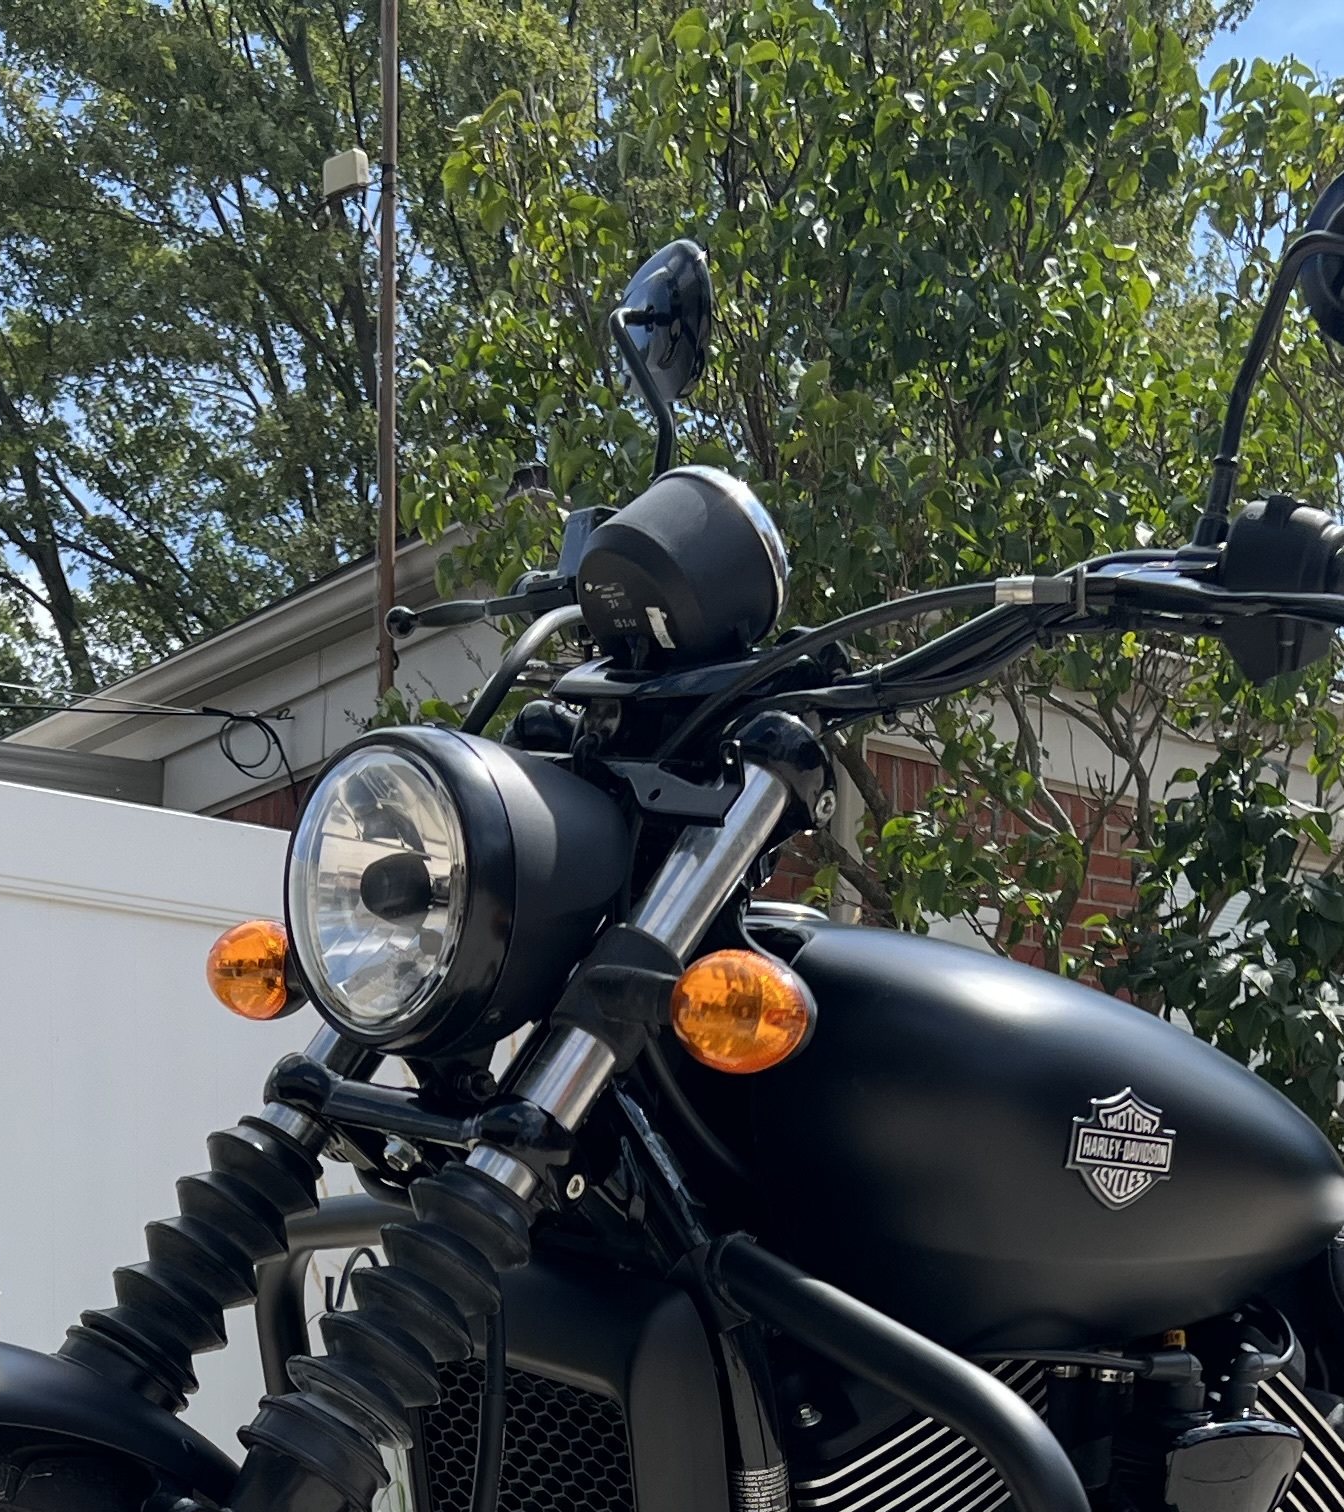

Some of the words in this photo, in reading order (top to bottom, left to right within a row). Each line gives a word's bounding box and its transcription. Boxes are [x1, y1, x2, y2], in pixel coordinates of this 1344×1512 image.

[1107, 1107, 1152, 1134] MOTOR
[1081, 1135, 1168, 1166] HARLEY-DAVIDSON
[1100, 1167, 1145, 1198] CYCLES
